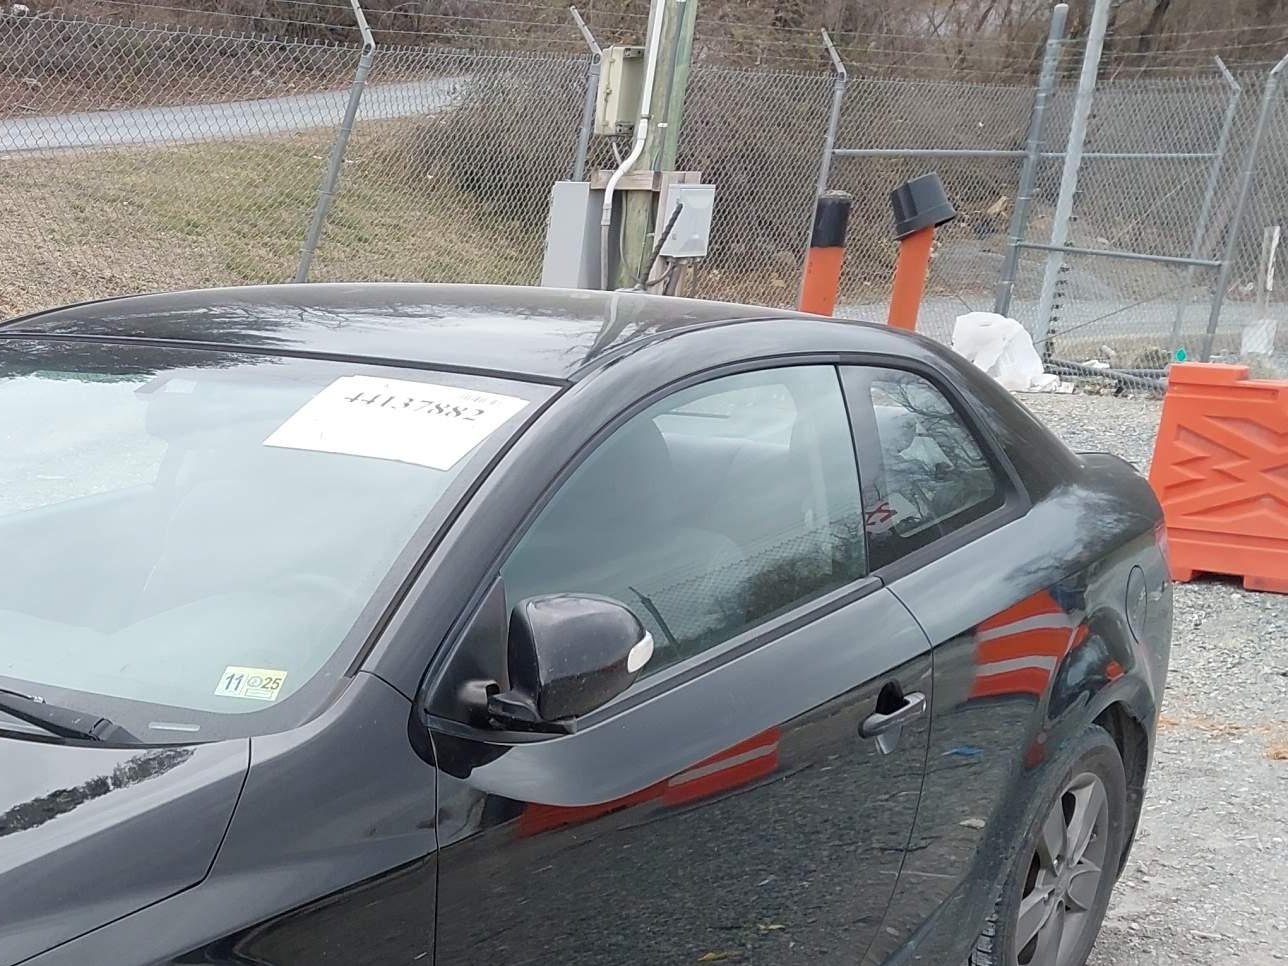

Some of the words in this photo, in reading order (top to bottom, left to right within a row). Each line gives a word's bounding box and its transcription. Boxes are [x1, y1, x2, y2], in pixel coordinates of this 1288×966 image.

[344, 392, 486, 421] 44137882
[225, 673, 244, 691] 11
[261, 676, 282, 690] 25
